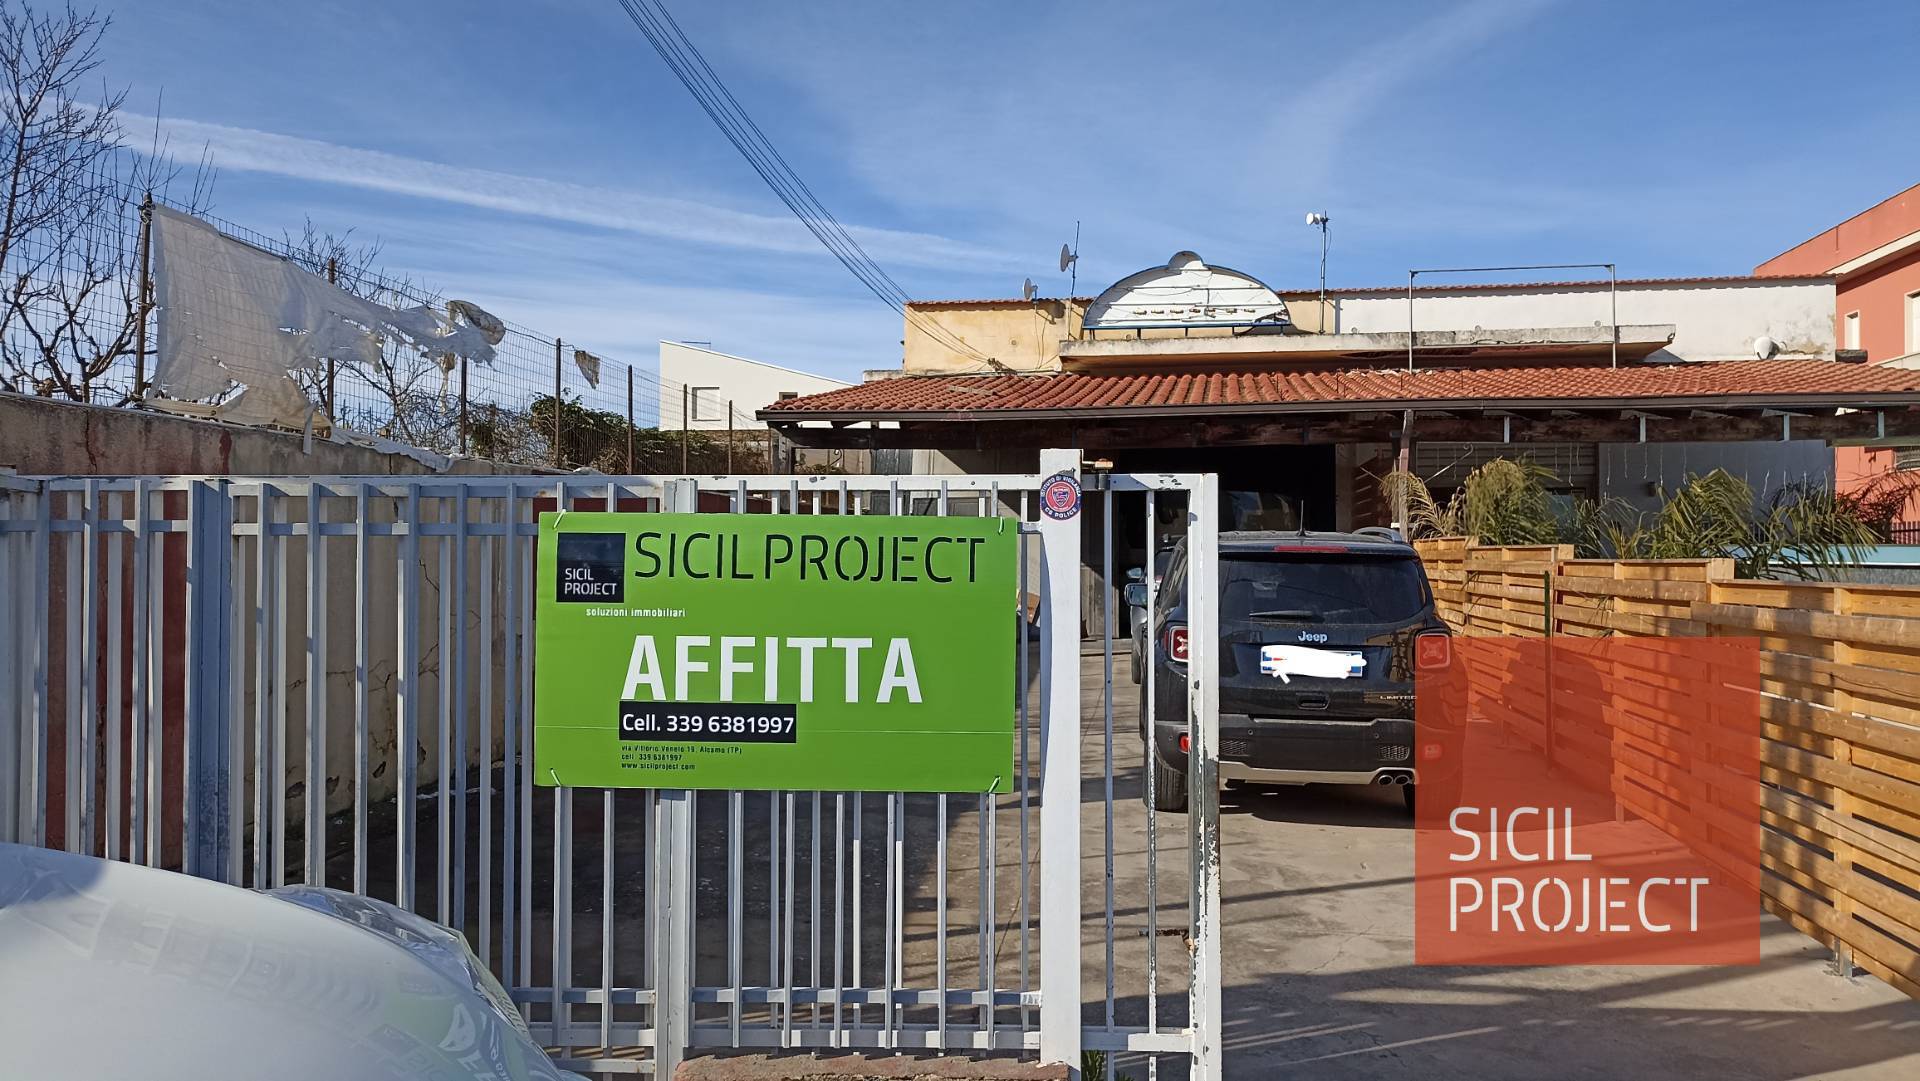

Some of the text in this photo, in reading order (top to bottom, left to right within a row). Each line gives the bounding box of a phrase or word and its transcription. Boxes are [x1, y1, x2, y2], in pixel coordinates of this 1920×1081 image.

[1054, 507, 1078, 518] POLICE
[634, 532, 986, 583] SICIL PROJECT
[564, 568, 594, 581] SICIL
[564, 582, 617, 596] PROJECT
[586, 607, 686, 618] soluzioni immobiliari
[1298, 631, 1328, 643] Jeep
[620, 635, 923, 703] AFFITTA
[622, 713, 795, 734] Cell. 339 6381997
